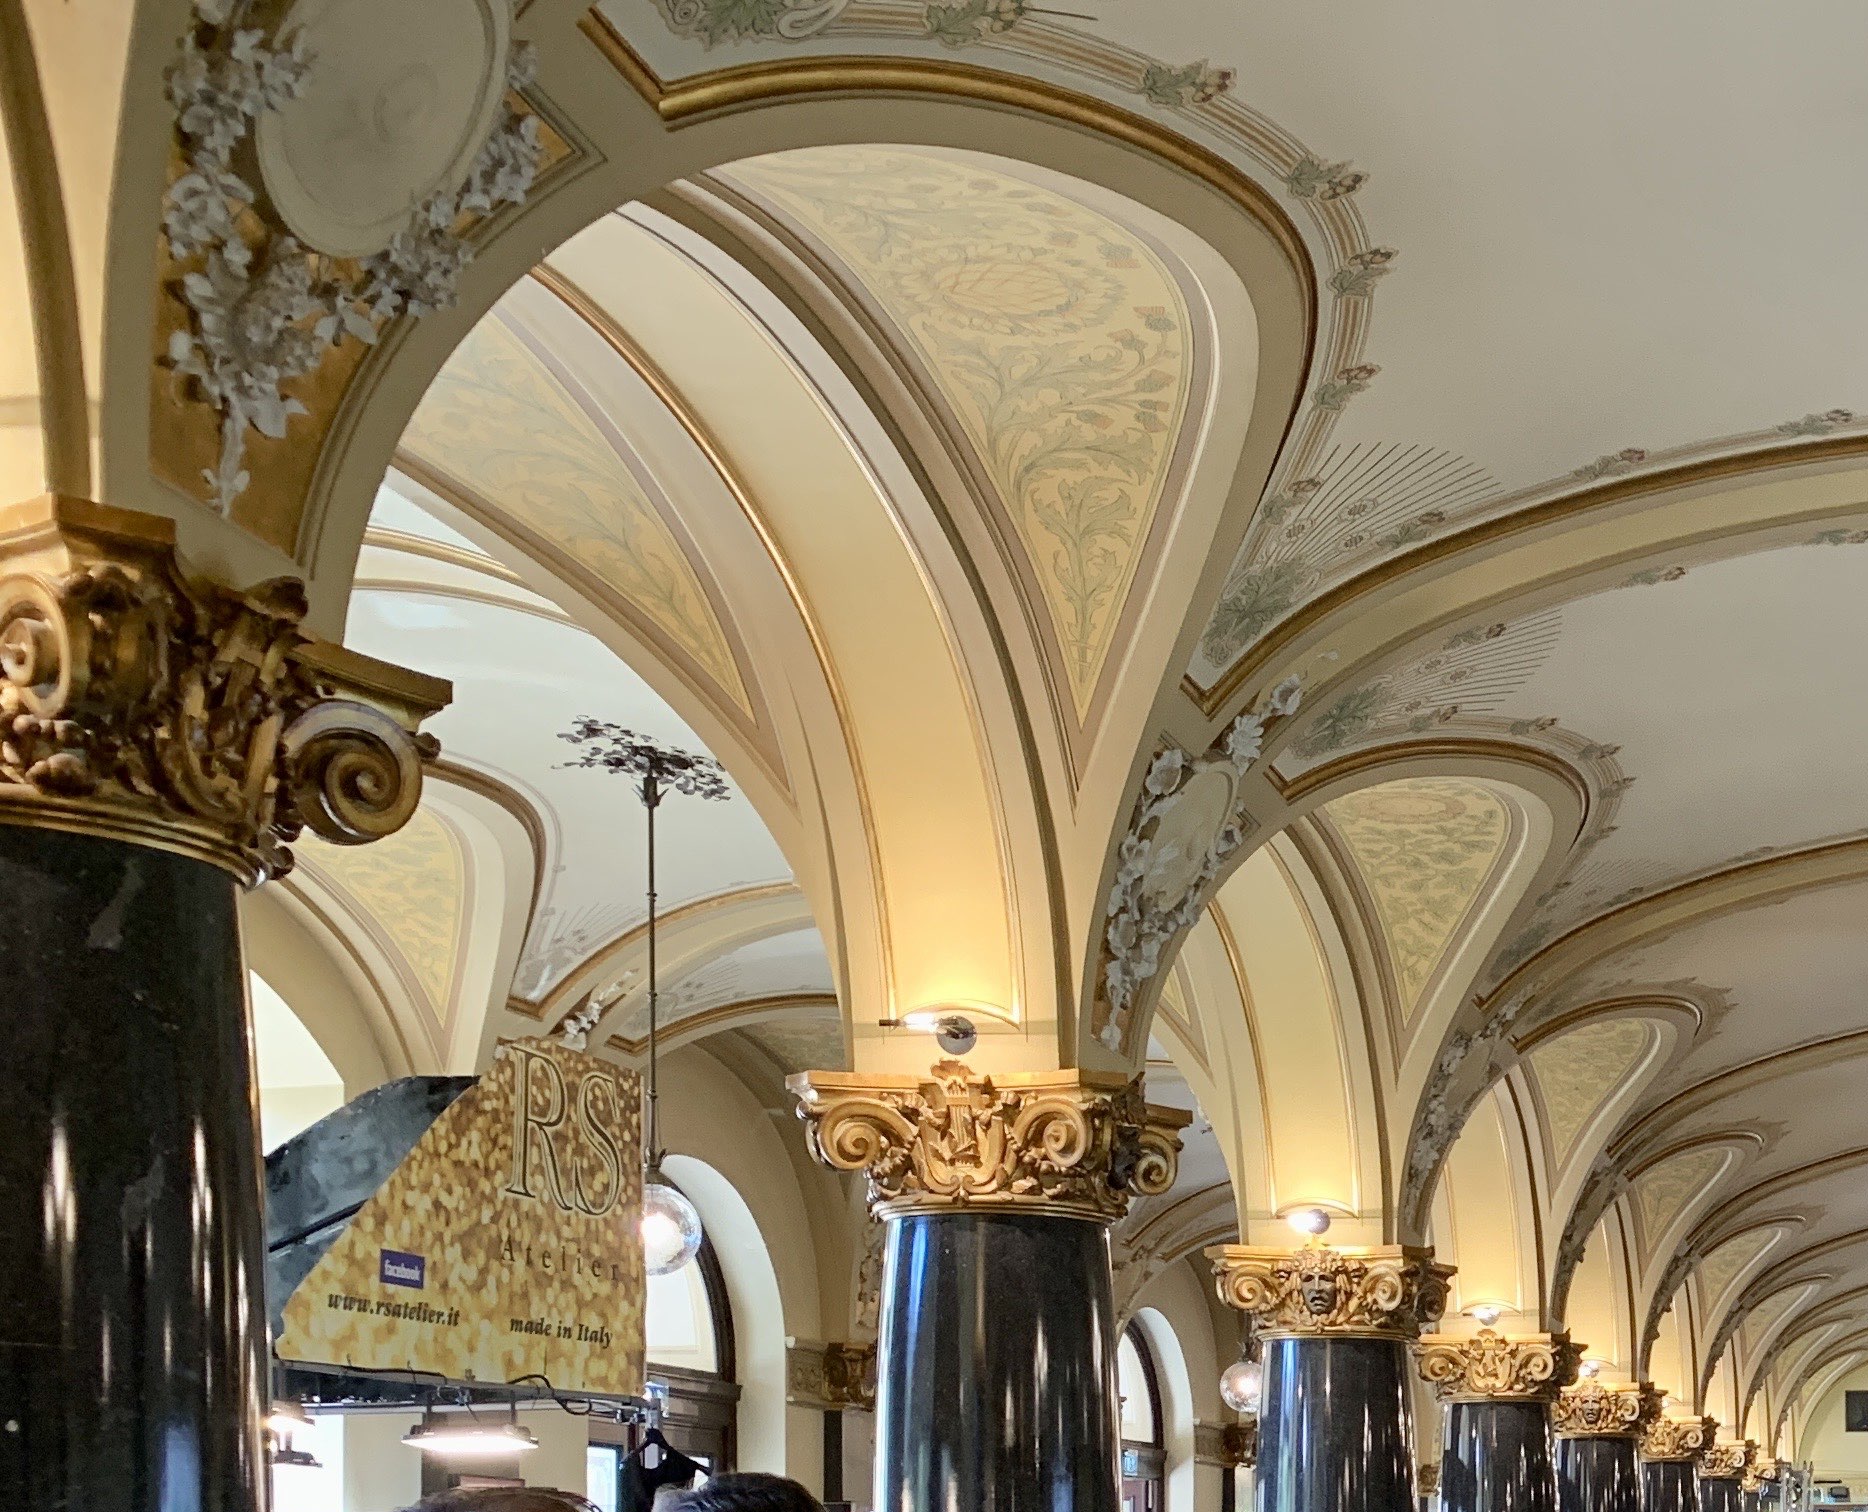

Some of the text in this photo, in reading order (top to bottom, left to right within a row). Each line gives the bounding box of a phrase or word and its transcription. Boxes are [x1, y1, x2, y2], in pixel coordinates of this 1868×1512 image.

[505, 1044, 621, 1216] RS
[384, 1258, 421, 1281] facebook
[501, 1235, 619, 1281] Atelier
[327, 1291, 460, 1328] www.rsatelier.it
[510, 1316, 613, 1348] made in Italy
